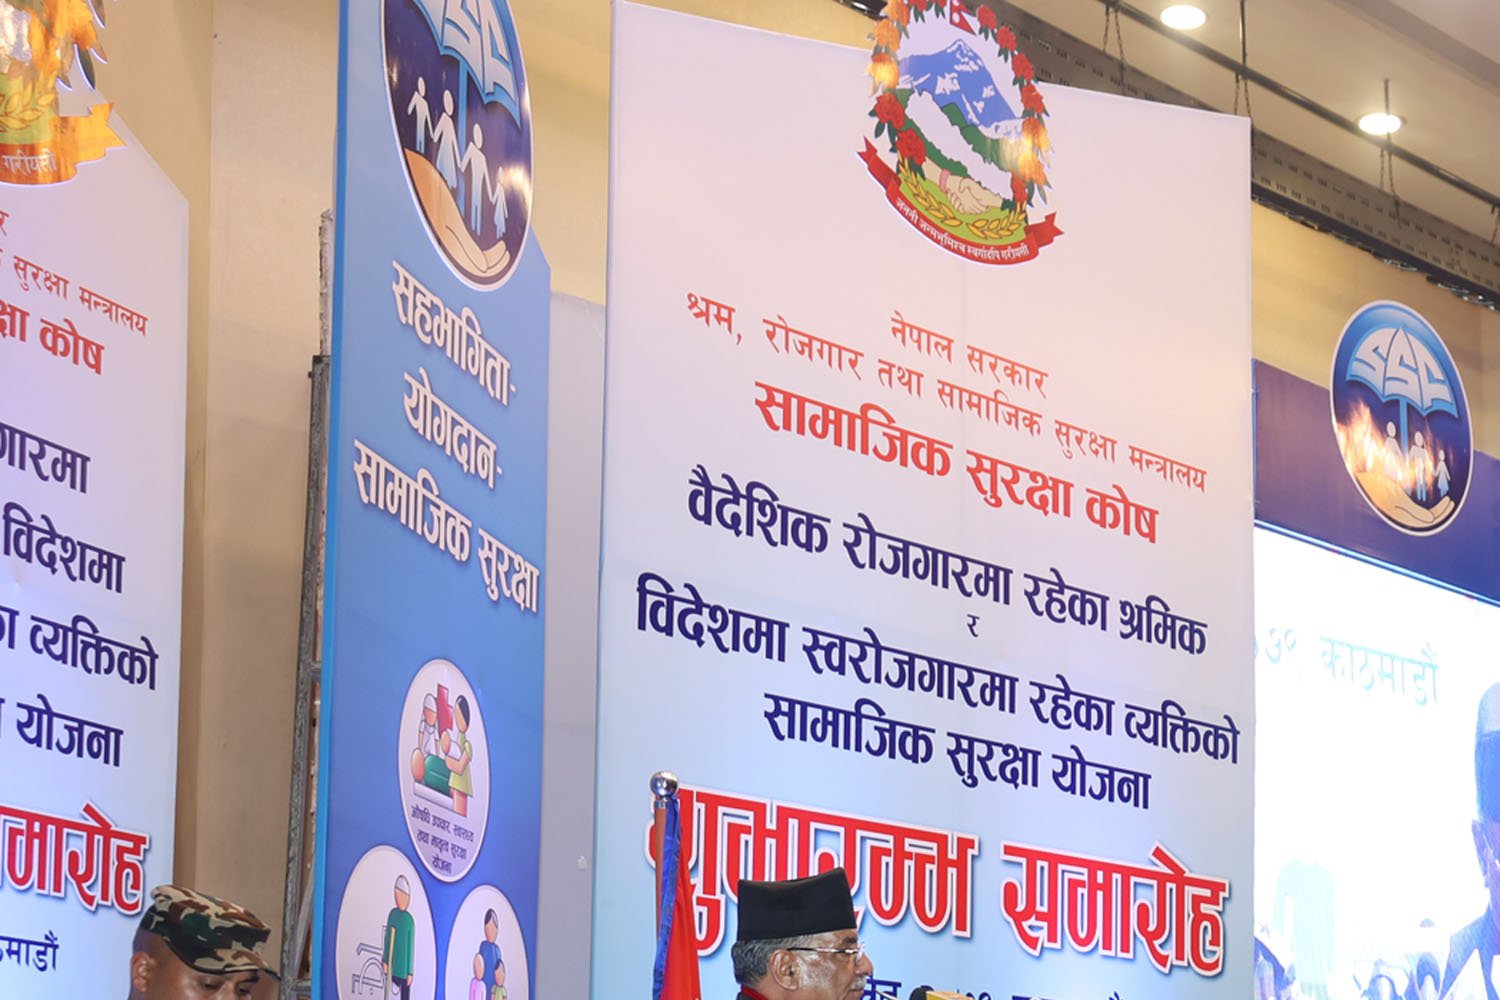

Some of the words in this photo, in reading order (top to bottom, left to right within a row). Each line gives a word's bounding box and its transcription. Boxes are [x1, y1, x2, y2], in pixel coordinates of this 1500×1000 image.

[14, 255, 69, 299] सुरक्षा
[79, 285, 148, 336] मन्त्रालय
[39, 318, 104, 375] कोष
[392, 260, 516, 406] सहभागिता-
[686, 292, 743, 344] श्रम,
[762, 314, 864, 380] रोजगार
[877, 359, 924, 398] तथा
[937, 379, 1043, 435] सामाजिक
[1054, 420, 1117, 462] सुरक्षा
[1128, 445, 1207, 493] मन्त्रालय
[891, 310, 954, 363] नेपाल
[967, 344, 1049, 399] सरकार
[0, 422, 91, 494] गारमा
[403, 367, 502, 489] योगदान-
[754, 380, 953, 477] सामाजिक
[966, 449, 1074, 518] सुरक्षा
[1085, 484, 1159, 544] कोष
[3, 501, 125, 593] विदेशमा
[353, 439, 472, 562] सामाजिक
[478, 527, 540, 613] सुरक्षा
[687, 464, 830, 553] वैदेशिक
[842, 512, 1012, 605] रोजगारमा
[1023, 567, 1109, 631] रहेका
[1119, 594, 1208, 655] श्रमिक
[30, 614, 159, 690] व्यक्तिको
[635, 572, 789, 663] विदेशमा
[801, 626, 1019, 714] स्वरोजगारमा
[1029, 674, 1114, 735] रहेका
[1124, 699, 1240, 764] व्यक्तिको
[966, 612, 980, 638] र
[16, 693, 124, 767] योजना
[763, 692, 936, 764] सामाजिक
[946, 731, 1041, 789] सुरक्षा
[1051, 744, 1151, 810] योजना
[0, 801, 150, 917] मारोह
[999, 840, 1231, 977] समारोह
[0, 930, 59, 972] माडौं
